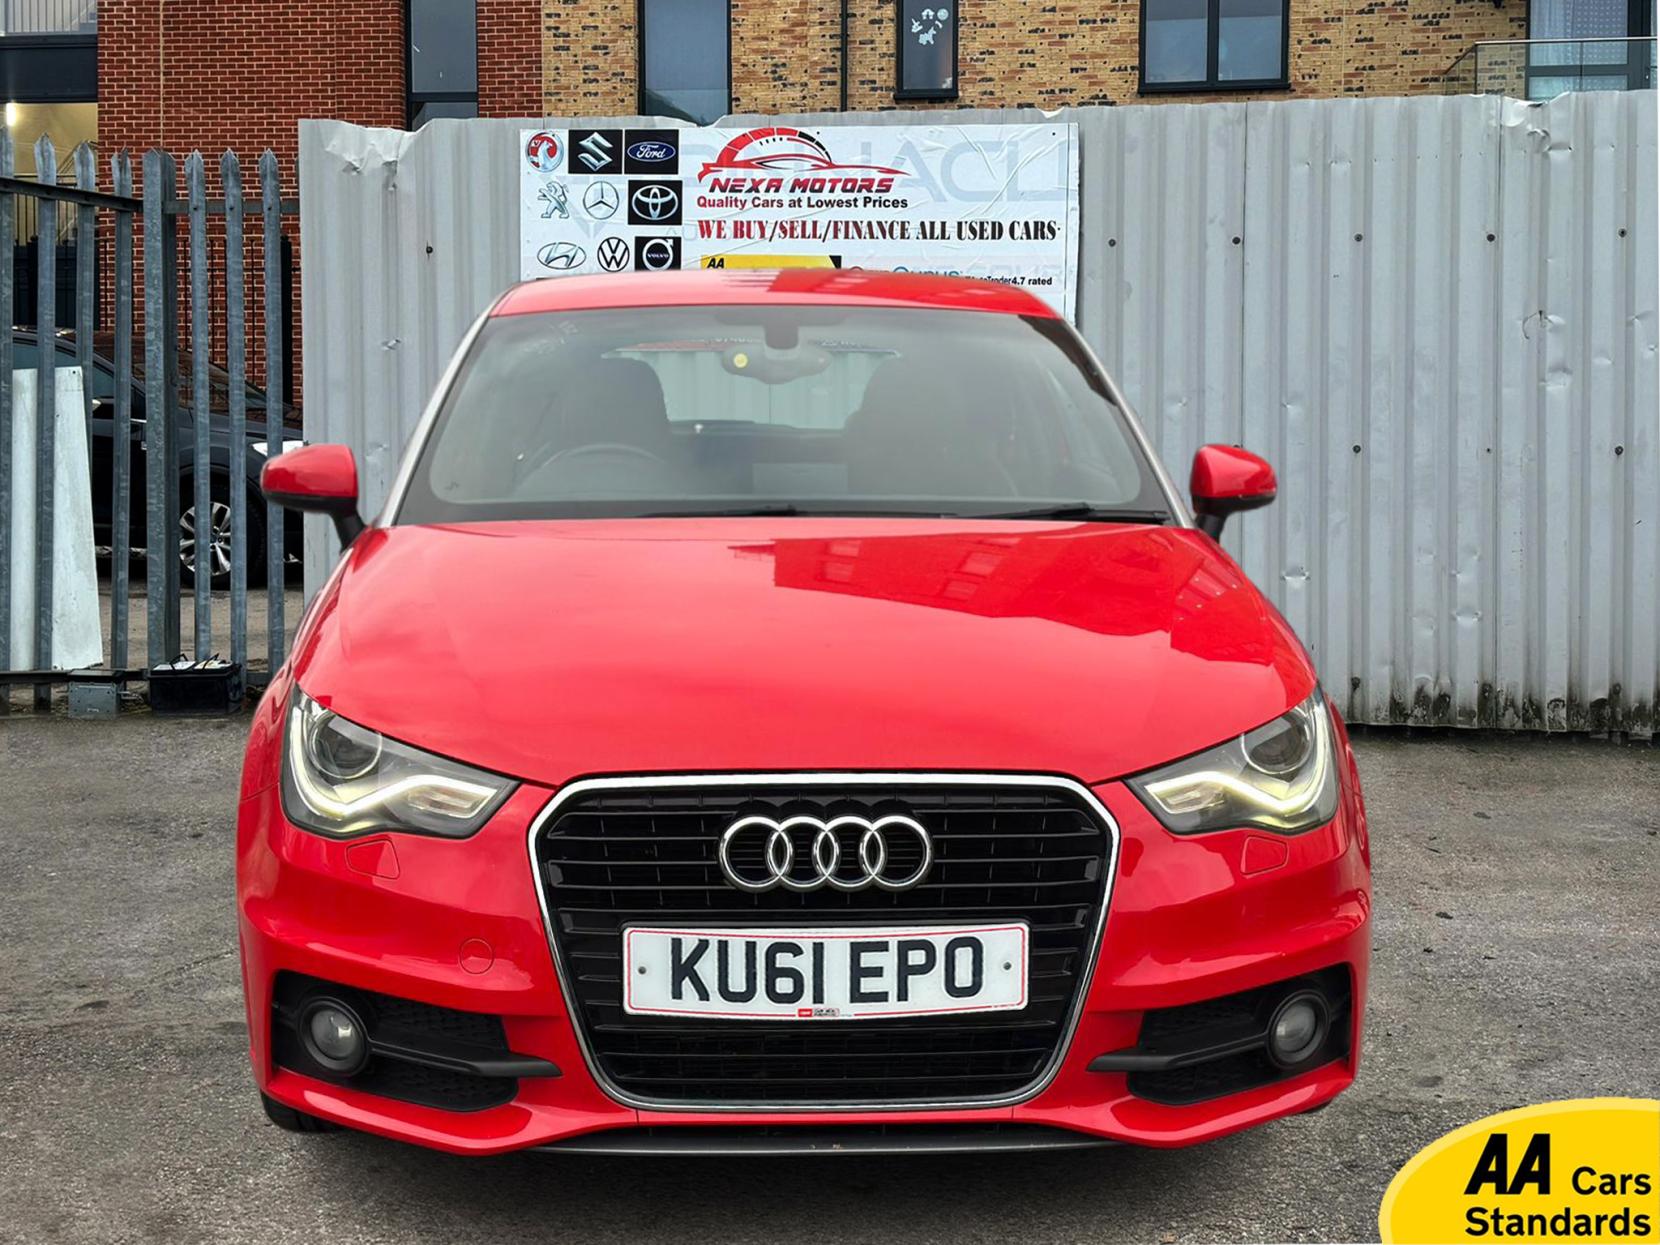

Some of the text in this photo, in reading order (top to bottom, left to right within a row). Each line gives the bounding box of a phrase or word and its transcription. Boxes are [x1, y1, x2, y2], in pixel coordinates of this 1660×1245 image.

[636, 144, 666, 158] Ford
[709, 178, 894, 193] NEXA MOTORS
[697, 195, 909, 211] Quality Cars at Lowest Prices
[697, 219, 726, 240] WE
[916, 220, 950, 240] ALL
[957, 220, 1004, 241] USED
[1009, 220, 1056, 241] CARS
[707, 257, 725, 268] AA
[1028, 276, 1053, 286] rated
[671, 936, 984, 1005] KU61 EPO
